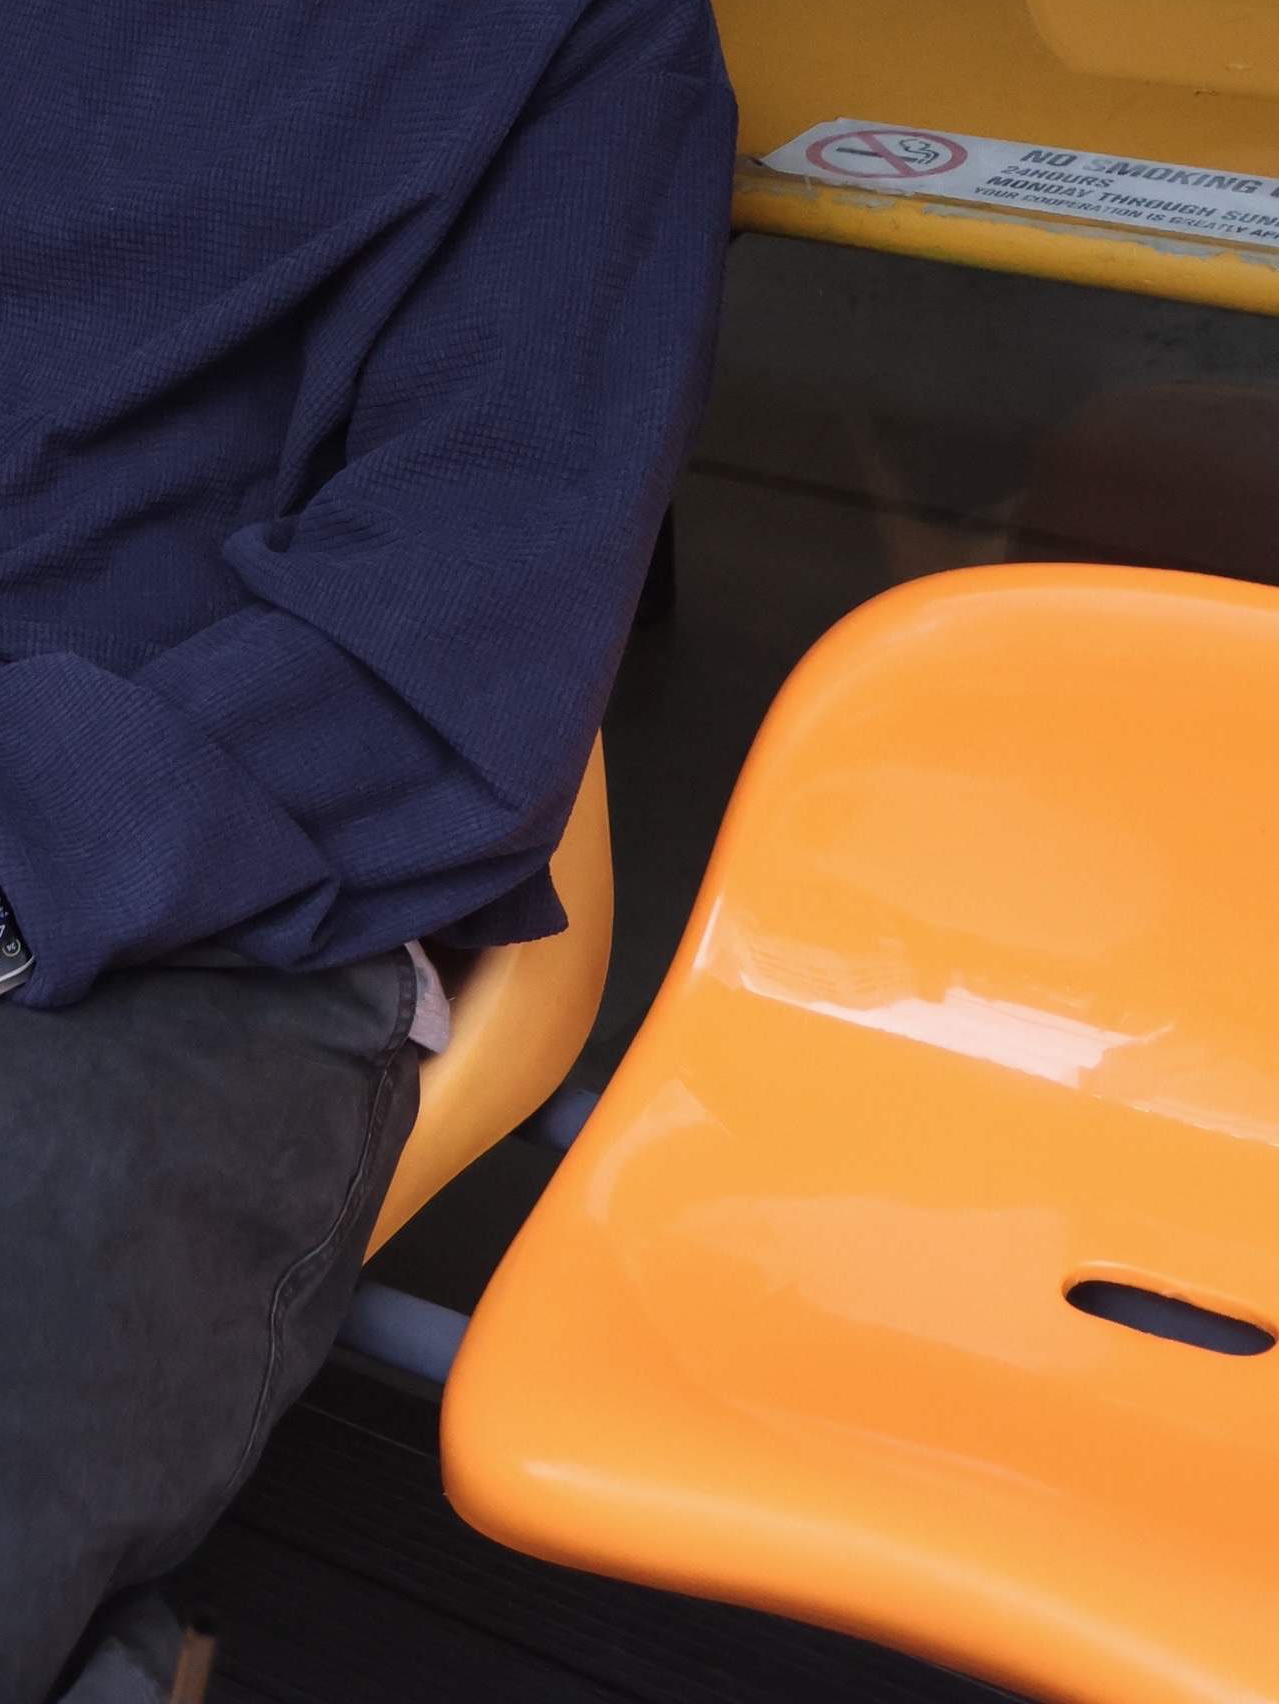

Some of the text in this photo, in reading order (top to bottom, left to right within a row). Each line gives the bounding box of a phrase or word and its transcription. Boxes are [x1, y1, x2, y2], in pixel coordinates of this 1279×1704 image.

[1000, 165, 1114, 188] 24HOURS
[1020, 149, 1078, 167] NO
[1081, 158, 1263, 194] SMOKING
[974, 187, 1020, 199] YOUR
[1021, 194, 1143, 218] COOPERATION
[1146, 212, 1166, 221] IS
[1168, 216, 1248, 233] GREATLY
[986, 176, 1279, 228] MONDAY THROUGH SUN
